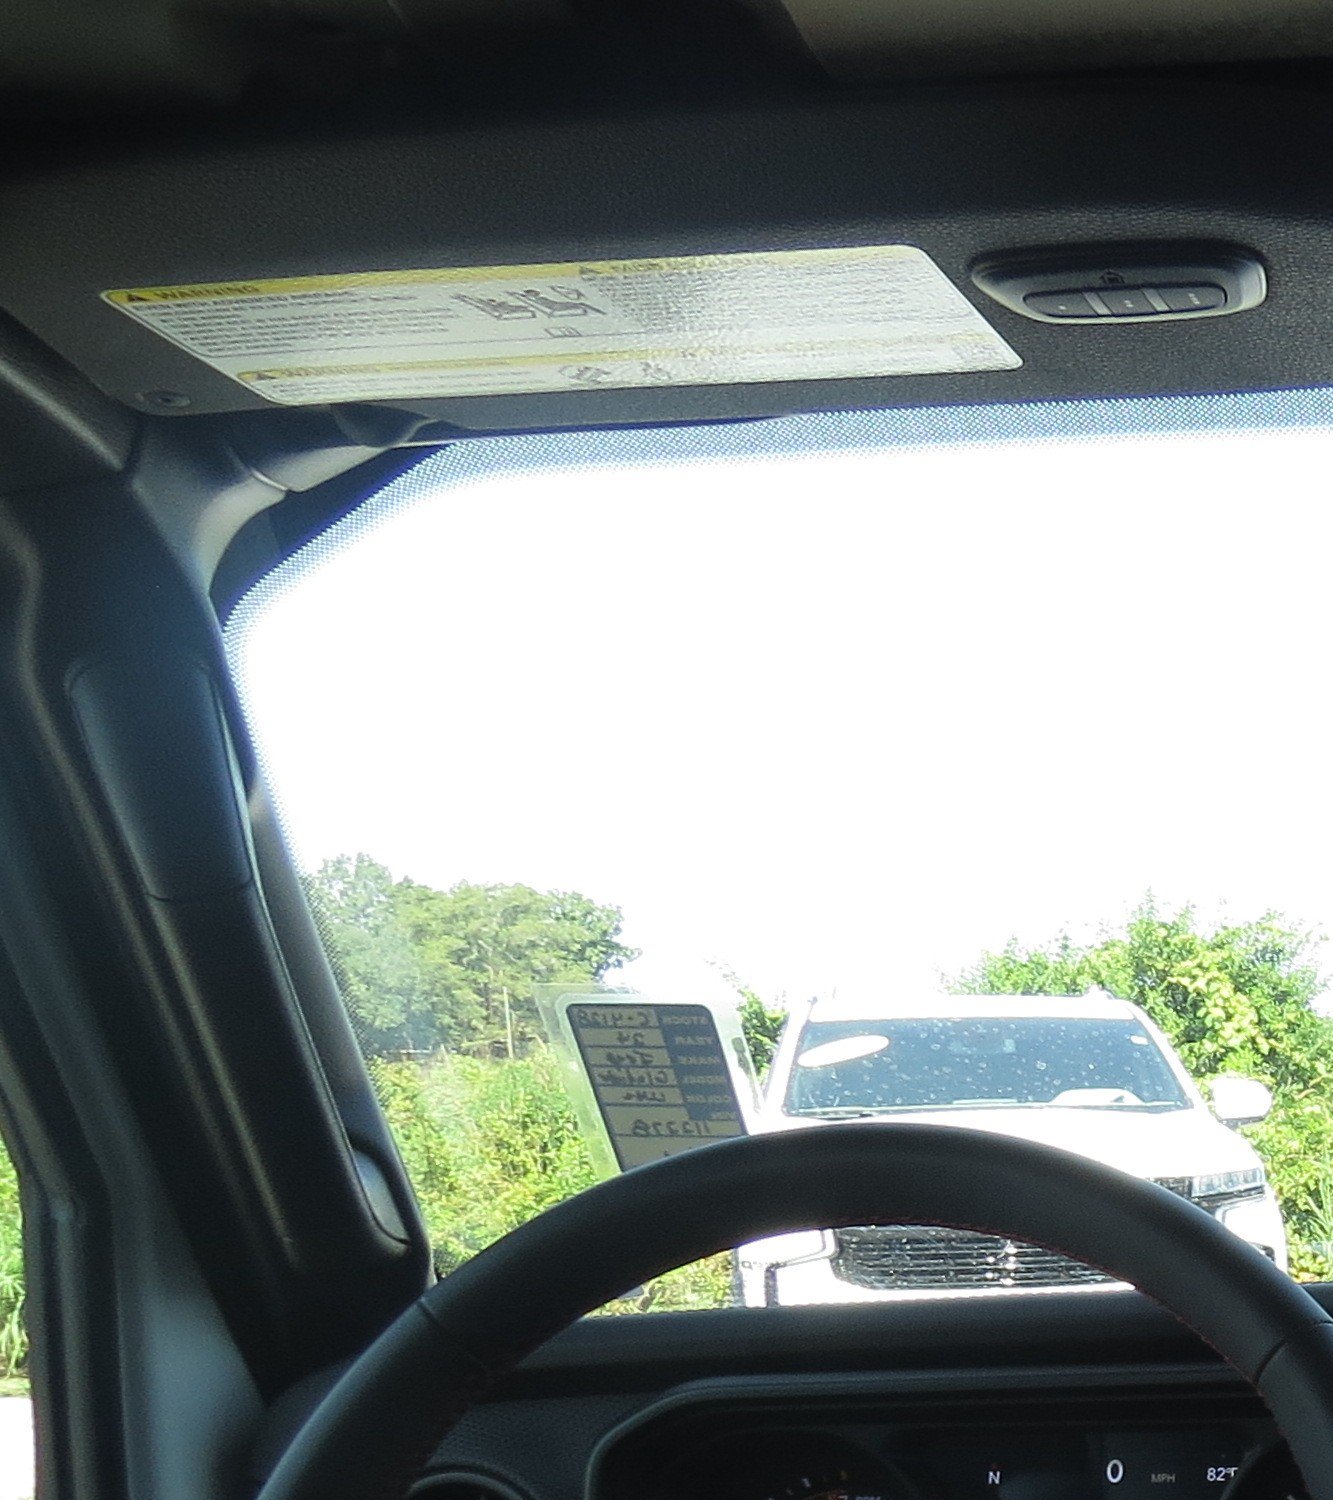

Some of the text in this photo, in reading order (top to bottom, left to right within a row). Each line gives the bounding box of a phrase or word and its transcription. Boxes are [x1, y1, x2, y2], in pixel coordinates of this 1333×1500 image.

[987, 1471, 1000, 1484] N
[1106, 1459, 1124, 1483] 0
[1151, 1473, 1176, 1483] MPH
